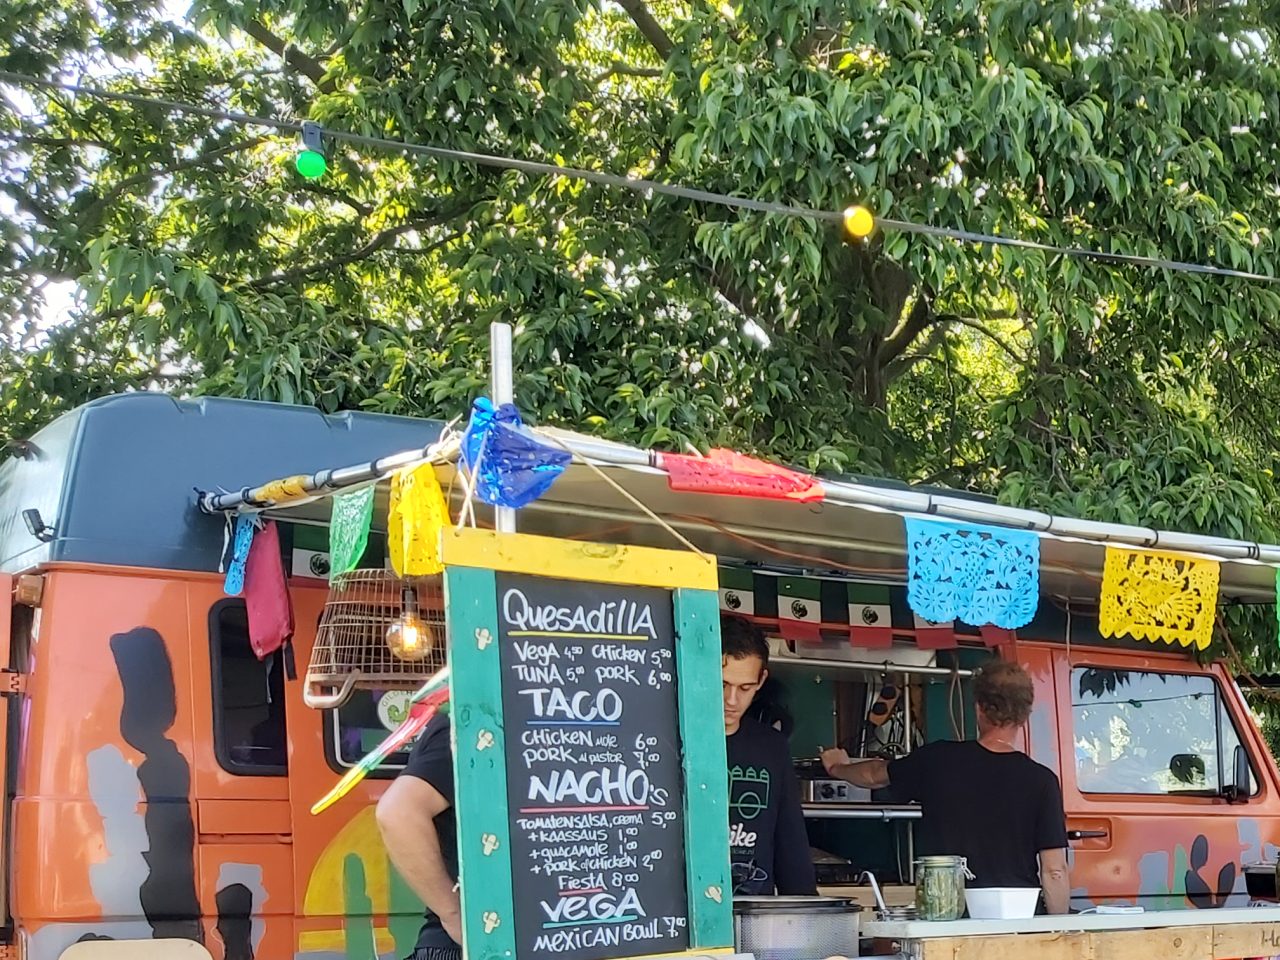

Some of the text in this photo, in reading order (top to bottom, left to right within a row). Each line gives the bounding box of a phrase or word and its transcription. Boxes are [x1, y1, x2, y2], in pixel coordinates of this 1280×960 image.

[382, 690, 416, 707] GILDEH
[518, 687, 624, 722] TACO
[730, 822, 757, 847] ike
